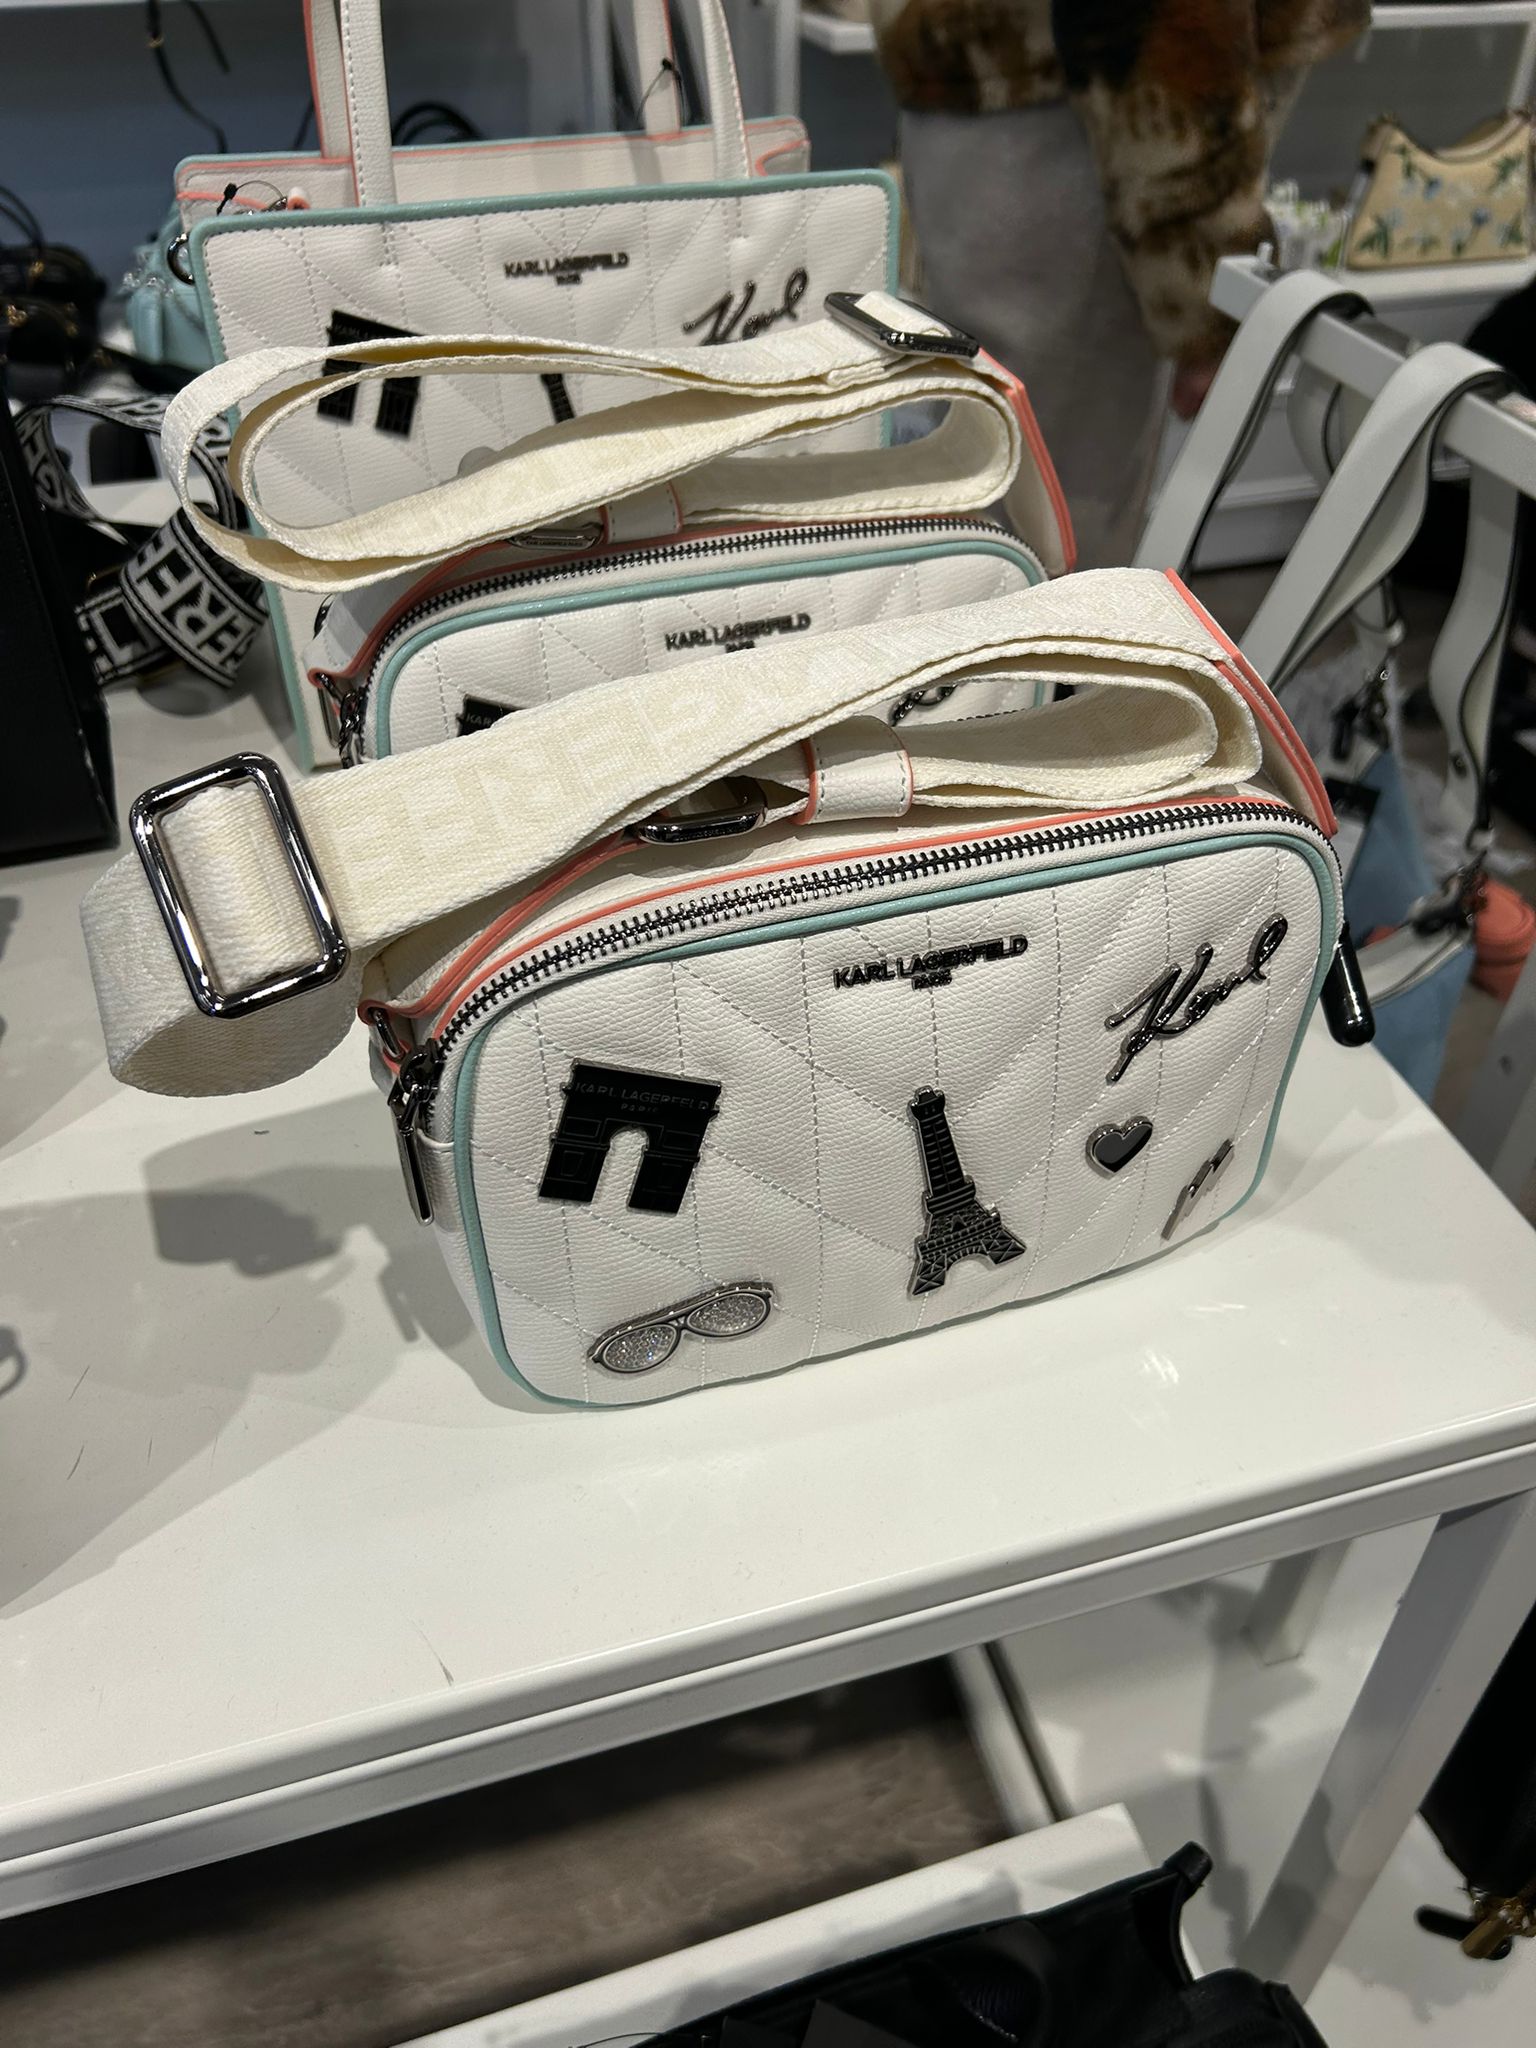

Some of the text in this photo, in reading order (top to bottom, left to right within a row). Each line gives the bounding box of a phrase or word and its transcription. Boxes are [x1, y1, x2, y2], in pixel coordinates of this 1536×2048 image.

[504, 260, 543, 277] KARL
[665, 612, 811, 650] KARL LAGERFELD
[833, 934, 1028, 990] KARL LAGERFELD
[911, 969, 953, 991] PARIS
[575, 1082, 710, 1110] KARL LAGERFELD
